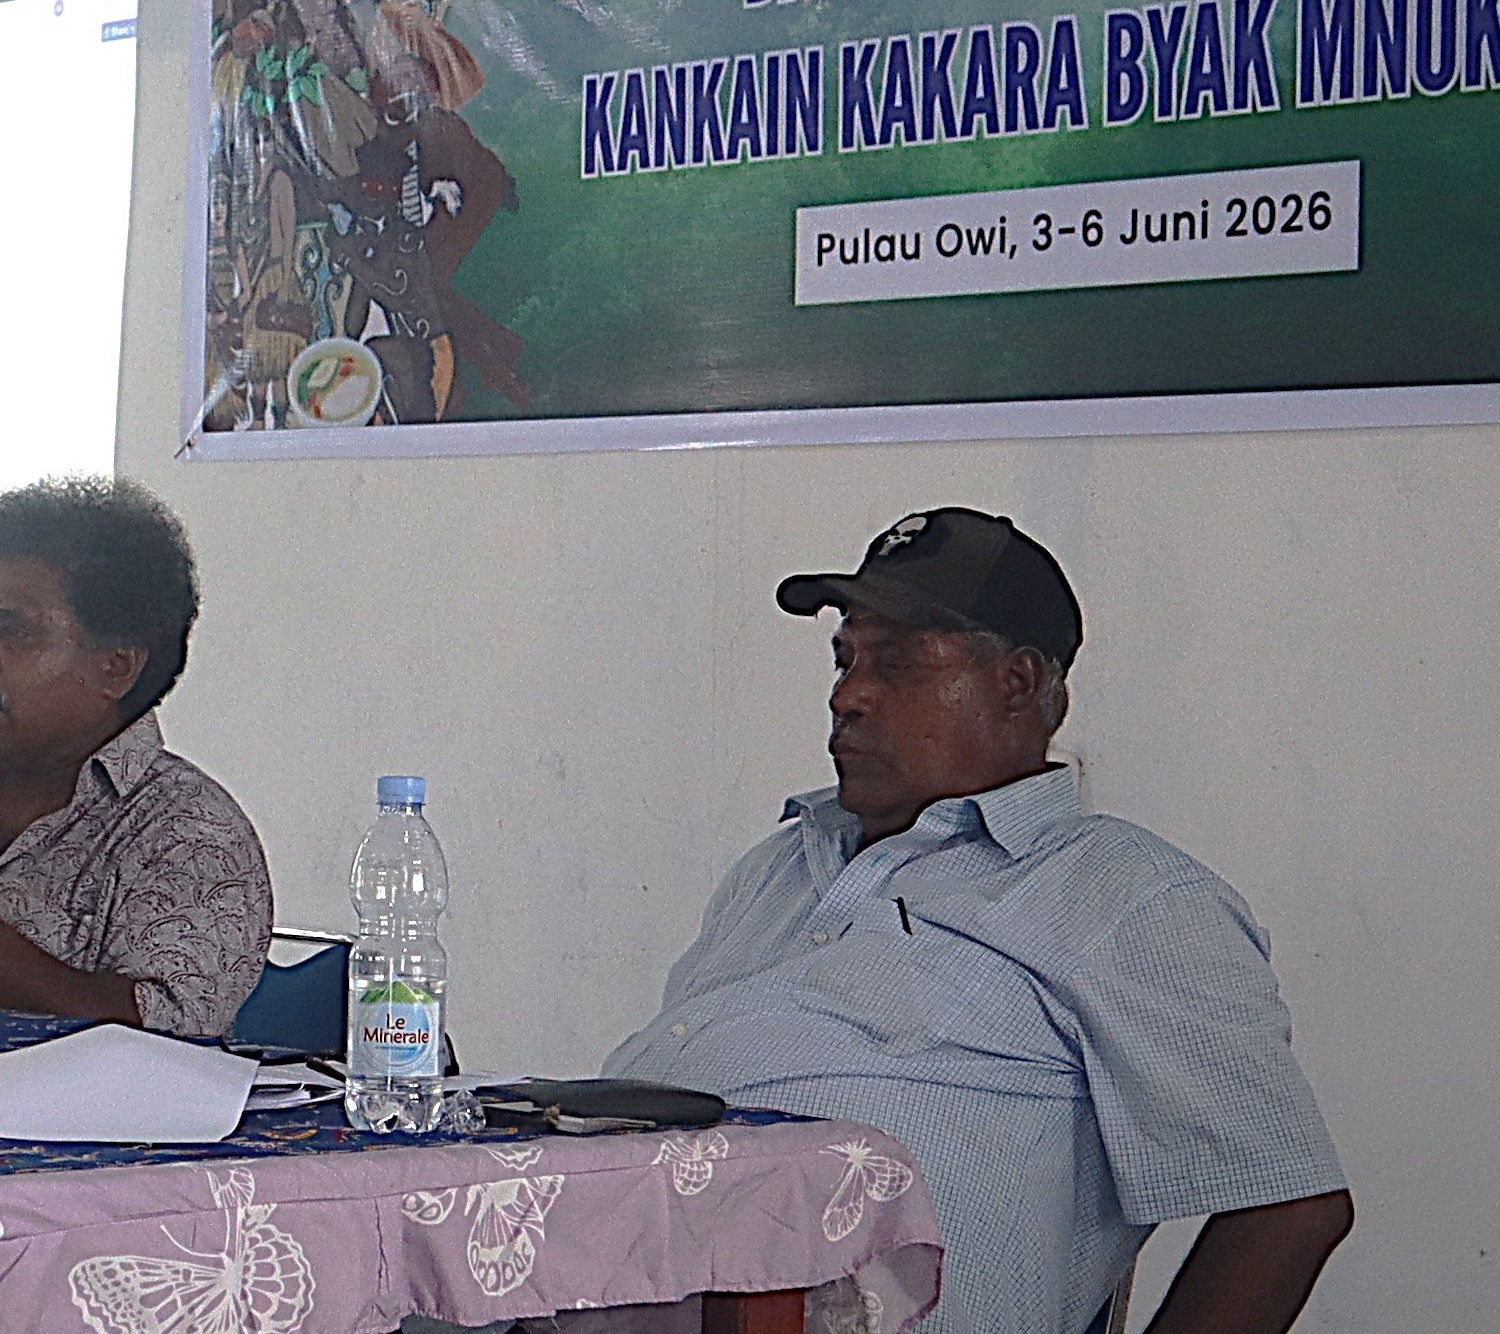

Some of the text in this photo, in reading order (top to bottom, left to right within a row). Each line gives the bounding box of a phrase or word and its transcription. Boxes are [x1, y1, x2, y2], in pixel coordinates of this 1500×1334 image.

[581, 45, 823, 179] KANKAIN
[838, 14, 1089, 153] KAKARA
[816, 190, 1333, 267] Pulau Owi, 3-6 Juni 2026
[363, 1027, 430, 1044] Minerale
[386, 1013, 406, 1030] Le
